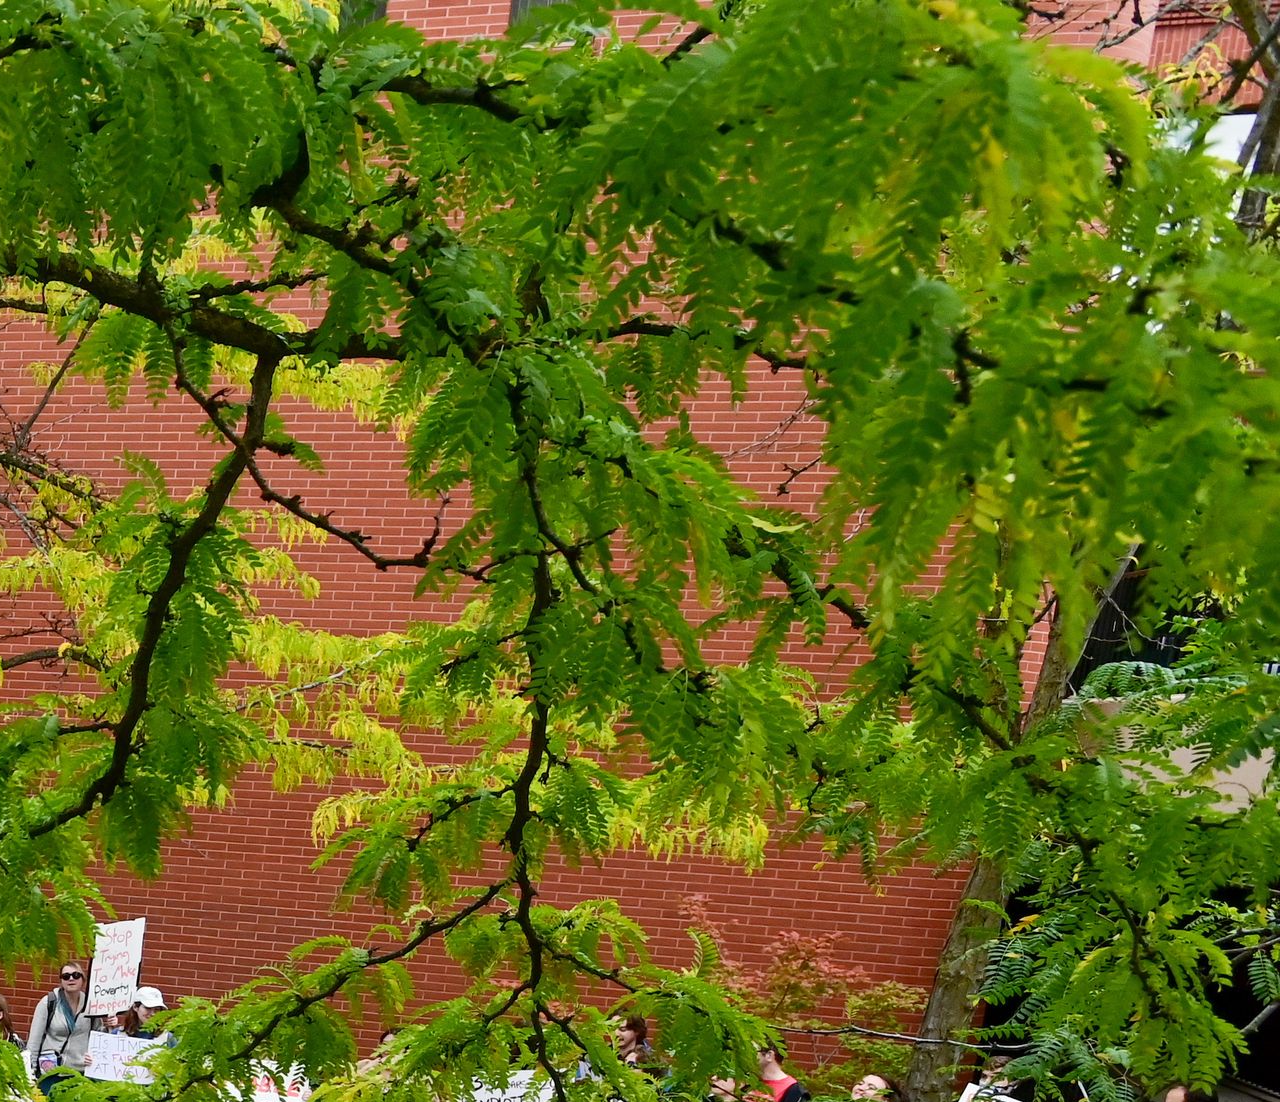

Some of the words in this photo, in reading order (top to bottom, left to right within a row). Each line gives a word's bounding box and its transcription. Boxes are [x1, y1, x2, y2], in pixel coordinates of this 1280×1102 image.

[105, 927, 133, 947] Stop
[100, 948, 130, 966] Trying
[93, 968, 108, 983] To
[112, 965, 137, 981] Make
[94, 983, 130, 998] Poverty
[88, 991, 132, 1015] Happen!
[115, 1036, 146, 1052] TIME
[93, 1063, 110, 1074] AT
